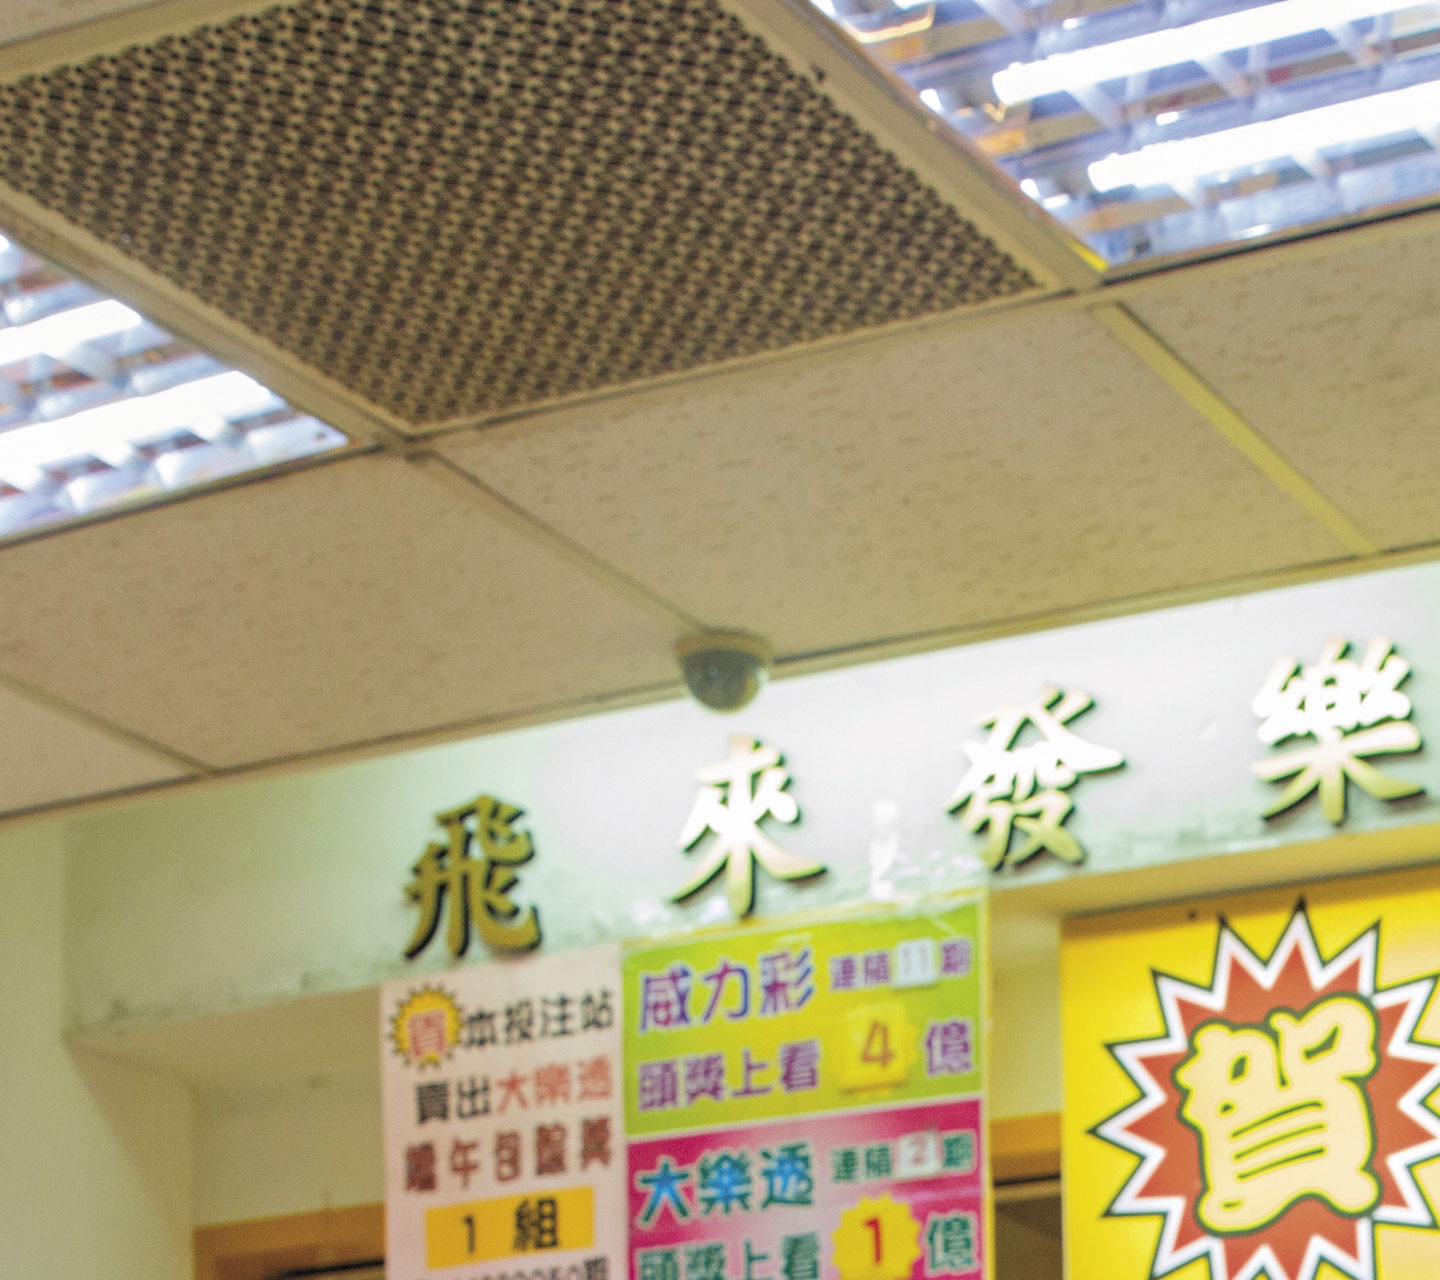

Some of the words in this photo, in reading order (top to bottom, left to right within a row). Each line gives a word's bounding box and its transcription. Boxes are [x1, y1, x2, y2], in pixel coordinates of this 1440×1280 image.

[462, 989, 614, 1048] 本投注站
[638, 947, 815, 1034] 威力彩
[1170, 991, 1385, 1236] 賀
[637, 1141, 815, 1228] 大樂透
